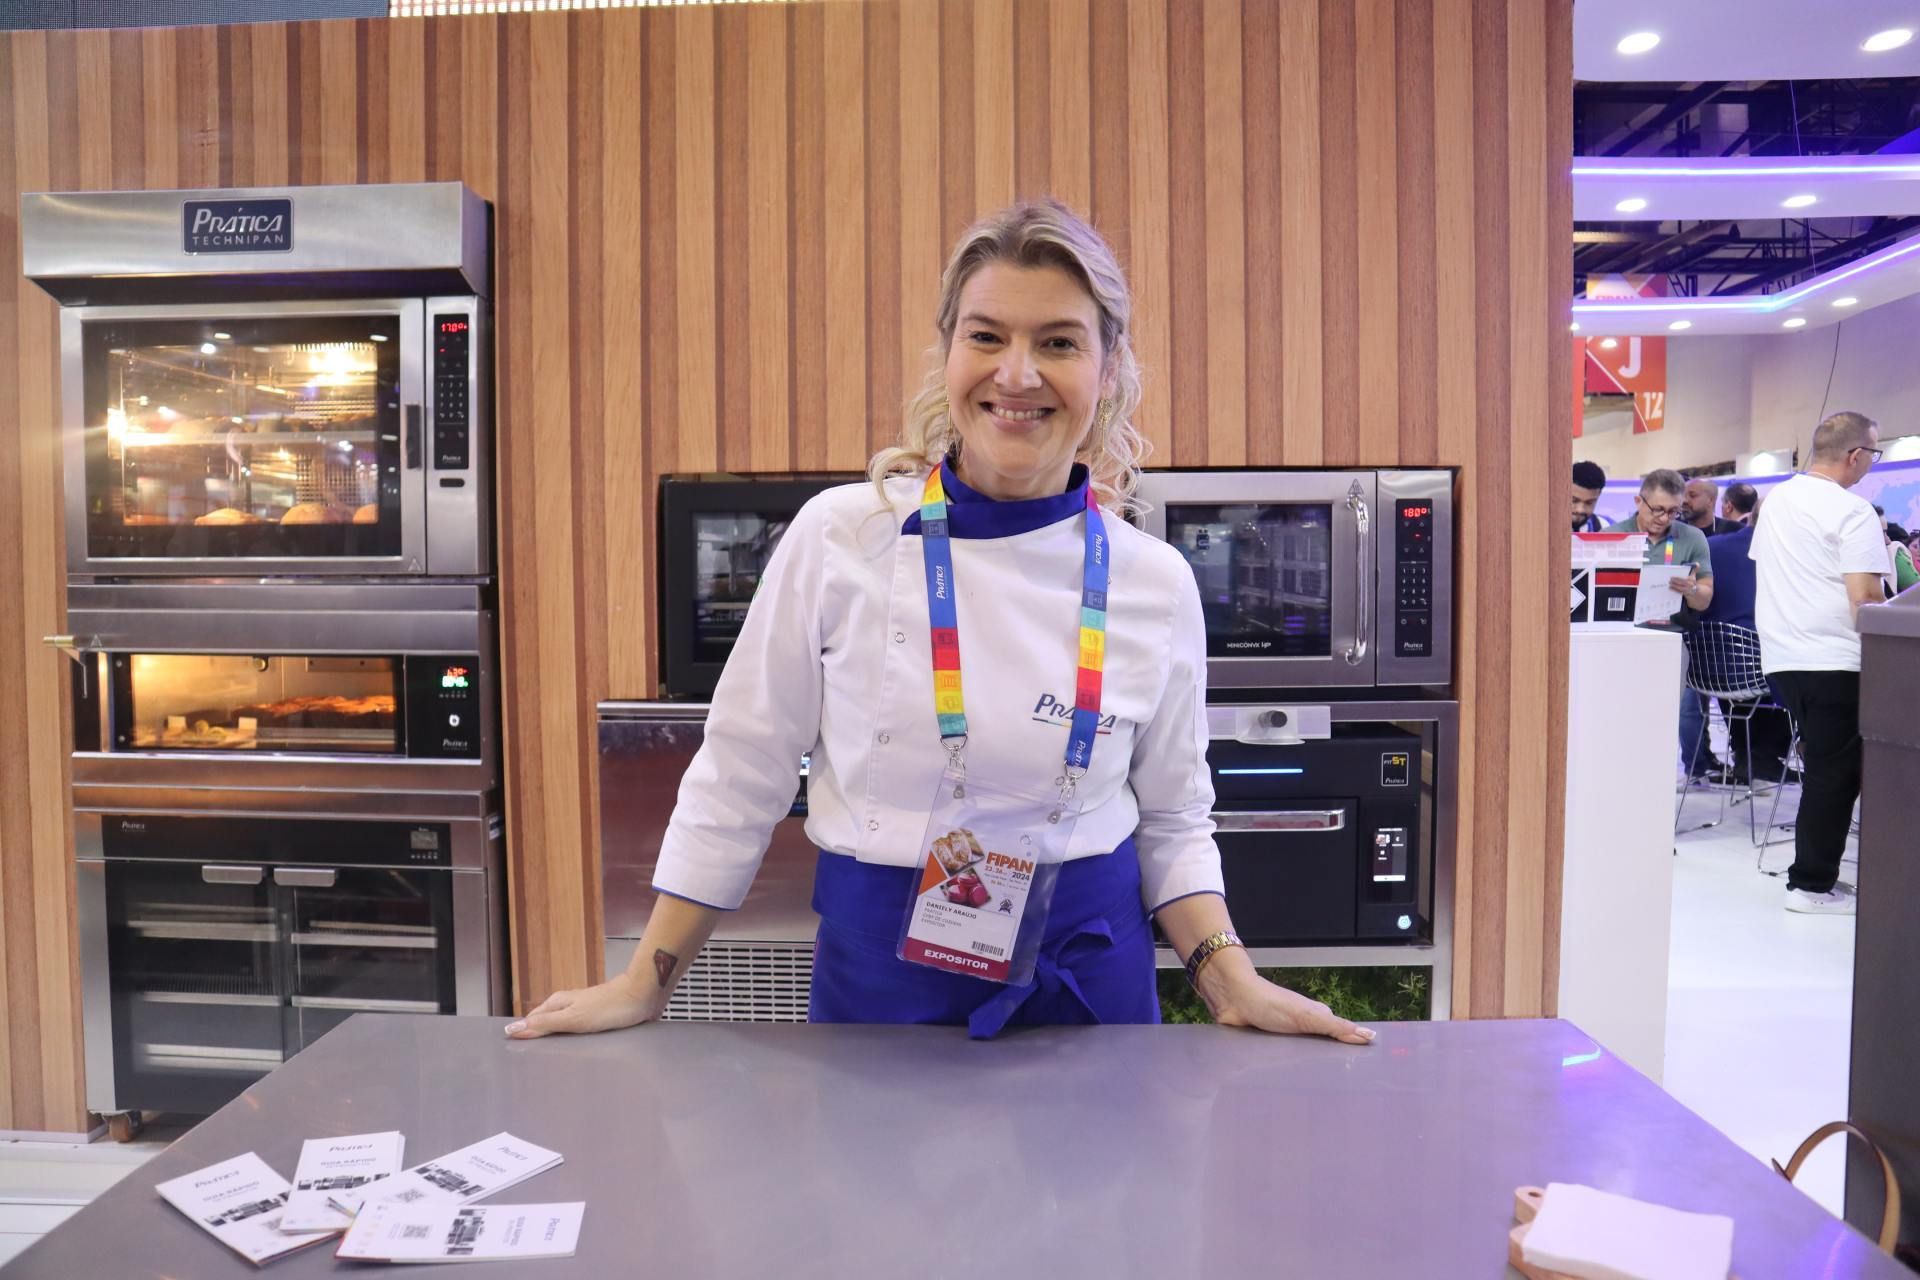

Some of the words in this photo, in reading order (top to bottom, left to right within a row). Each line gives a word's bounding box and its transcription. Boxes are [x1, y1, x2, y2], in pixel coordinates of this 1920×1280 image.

[192, 235, 284, 246] TECHNIPAN
[1643, 391, 1665, 421] 12
[987, 851, 1034, 874] FIPAN
[1012, 871, 1030, 881] 2024
[926, 901, 952, 912] DANIELY
[924, 949, 989, 971] EXPOSITOR
